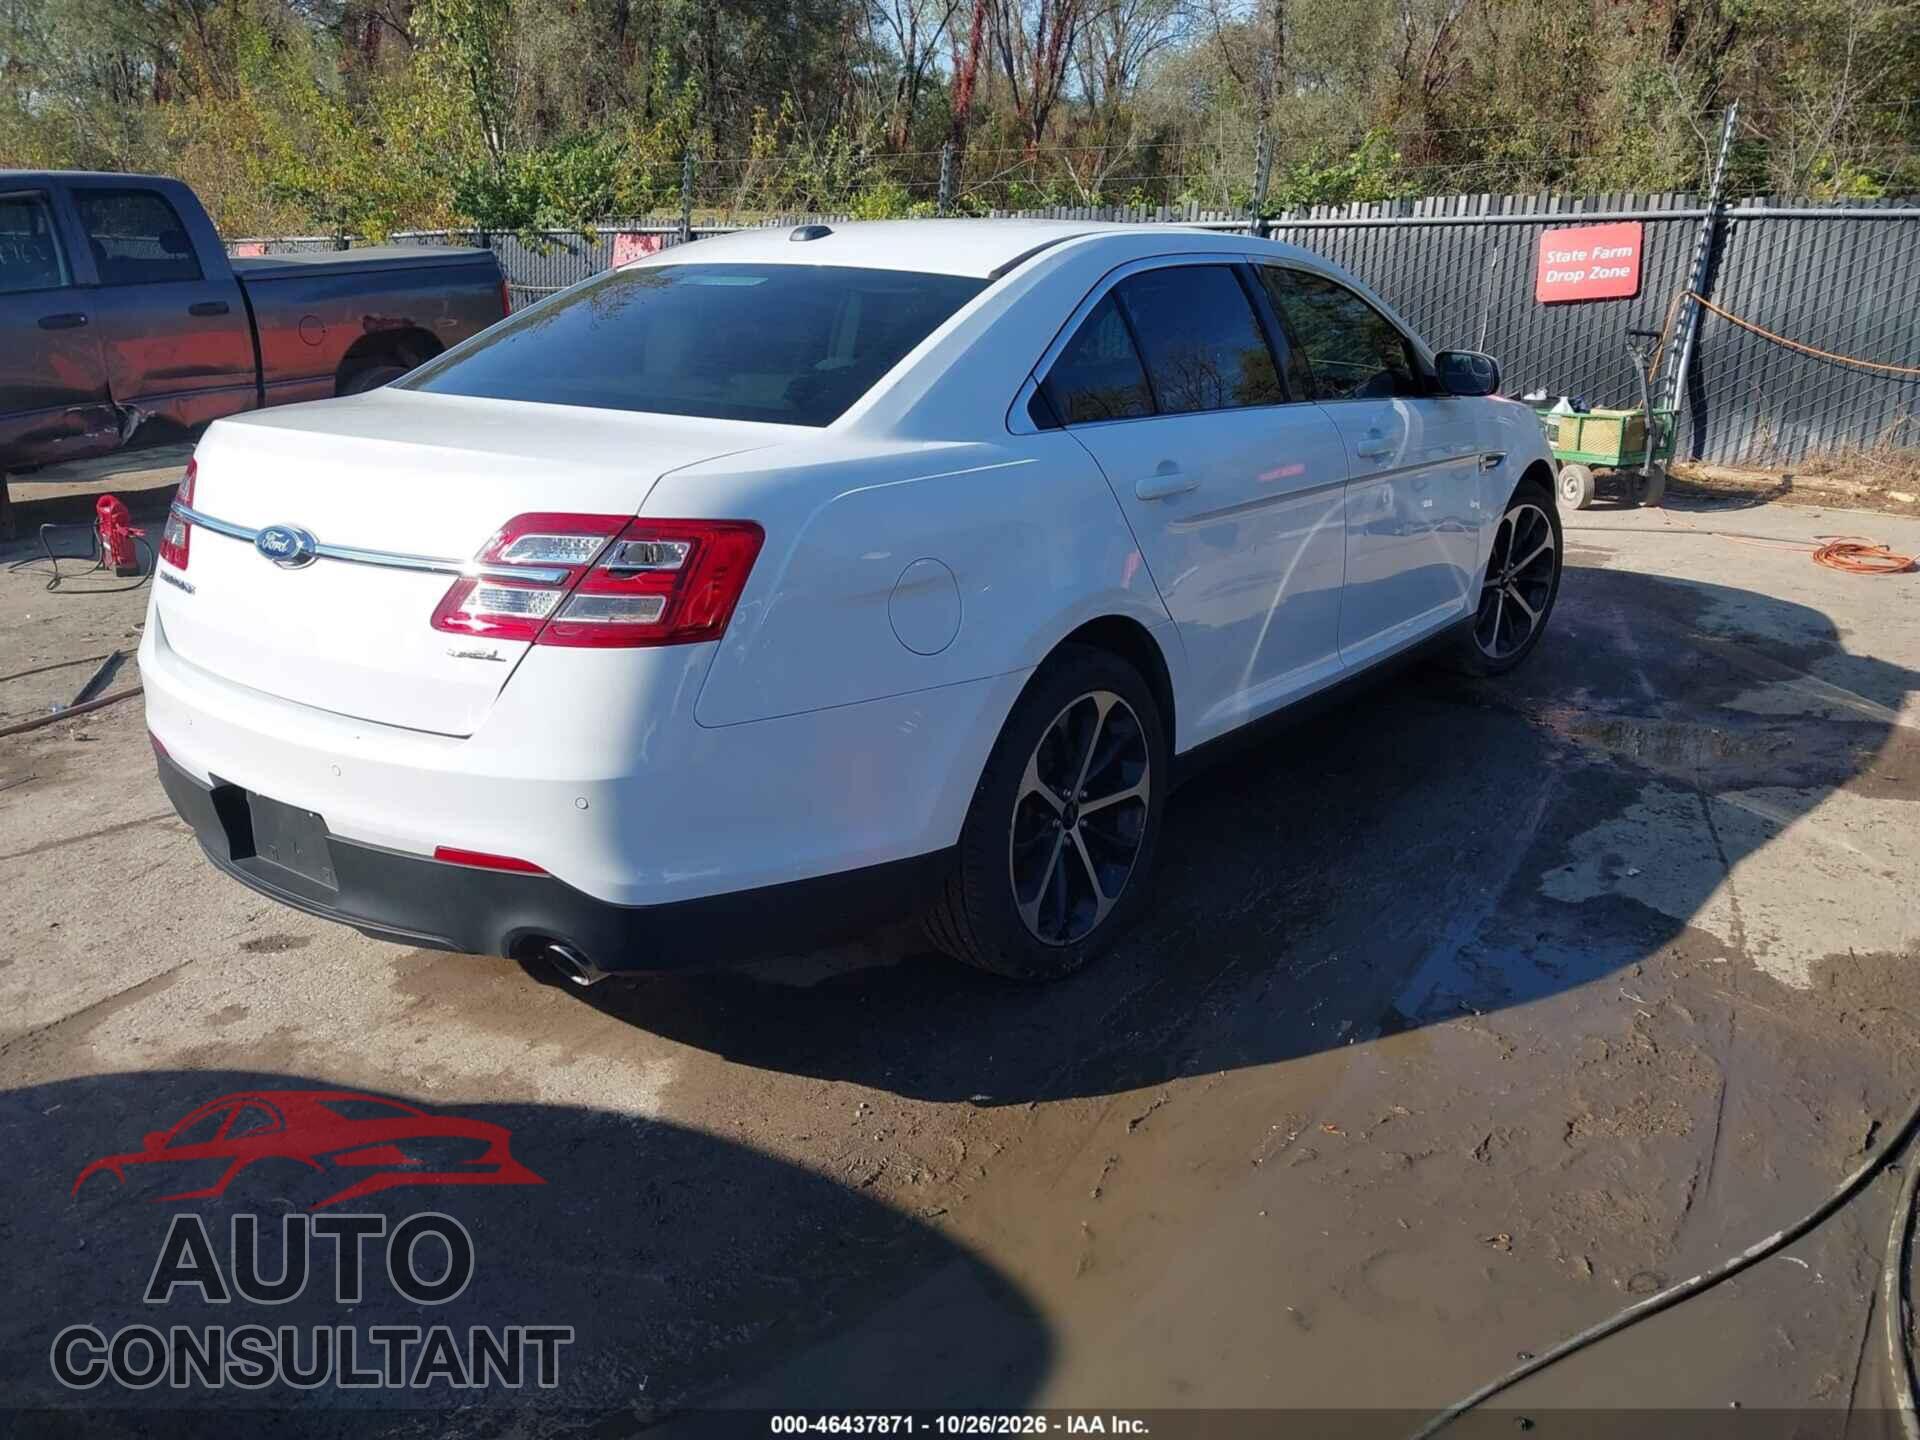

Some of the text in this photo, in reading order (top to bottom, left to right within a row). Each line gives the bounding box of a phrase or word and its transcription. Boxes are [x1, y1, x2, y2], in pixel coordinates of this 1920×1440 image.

[1545, 246, 1633, 265] State Farm
[1545, 265, 1631, 284] Drop Zone
[261, 530, 290, 553] Ford
